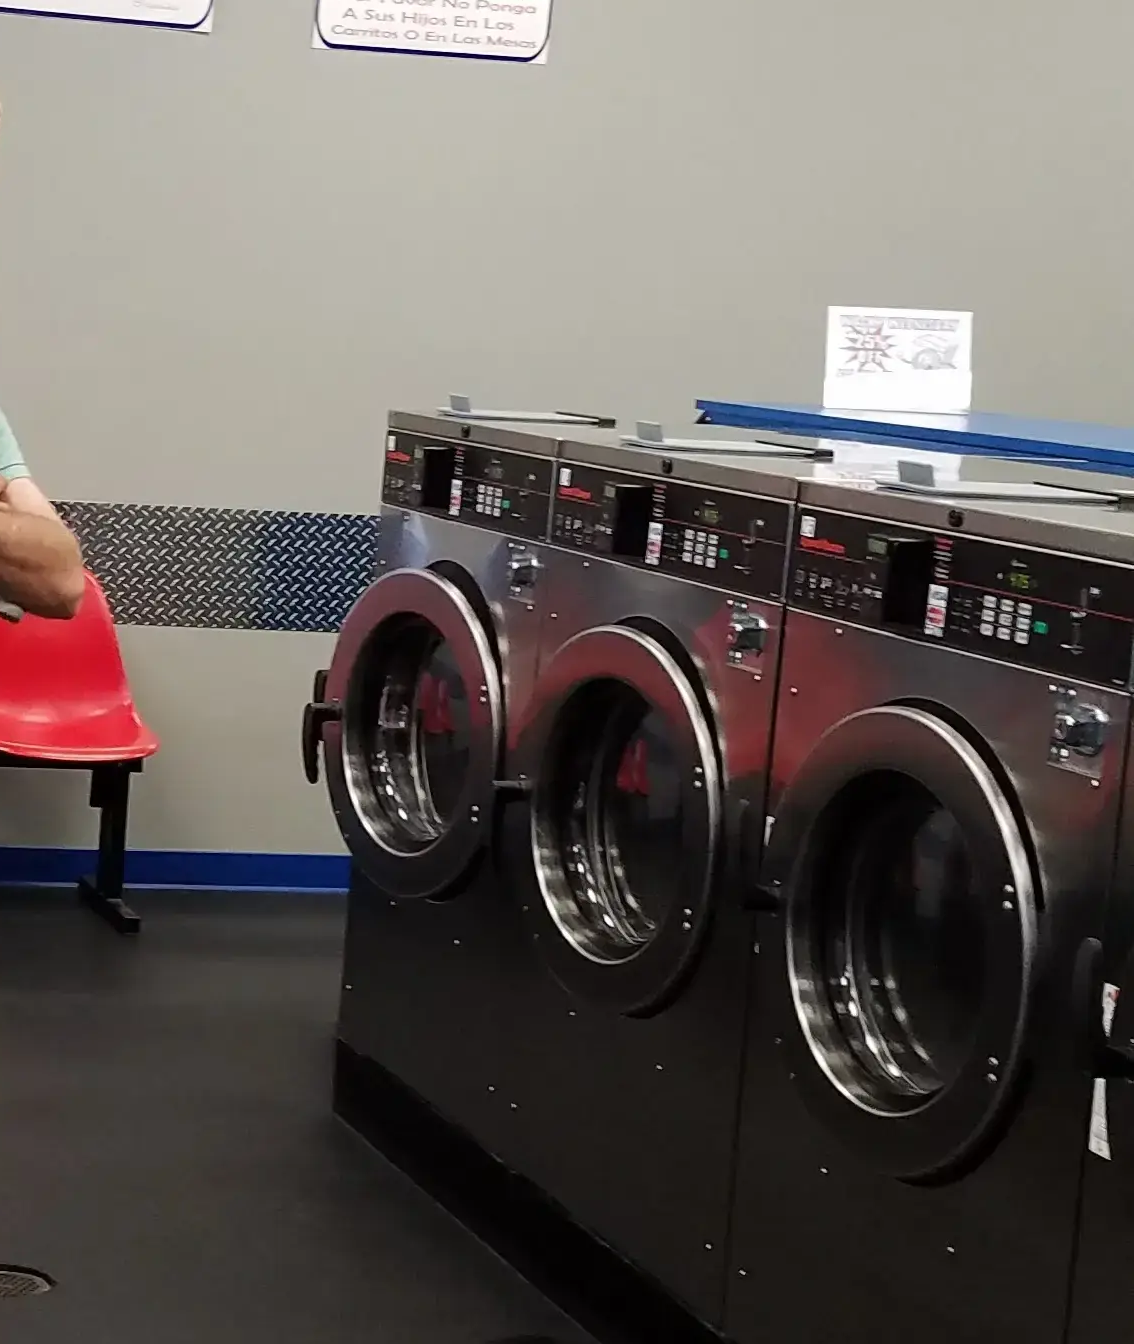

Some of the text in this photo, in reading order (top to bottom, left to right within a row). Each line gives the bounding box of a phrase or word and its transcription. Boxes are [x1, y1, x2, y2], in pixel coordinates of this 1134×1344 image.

[475, 0, 537, 15] Ponga
[342, 8, 357, 20] A
[365, 10, 394, 23] Sus
[401, 12, 447, 27] Hijos
[454, 16, 478, 29] En
[331, 25, 537, 50] Carritos O En Las Mesas
